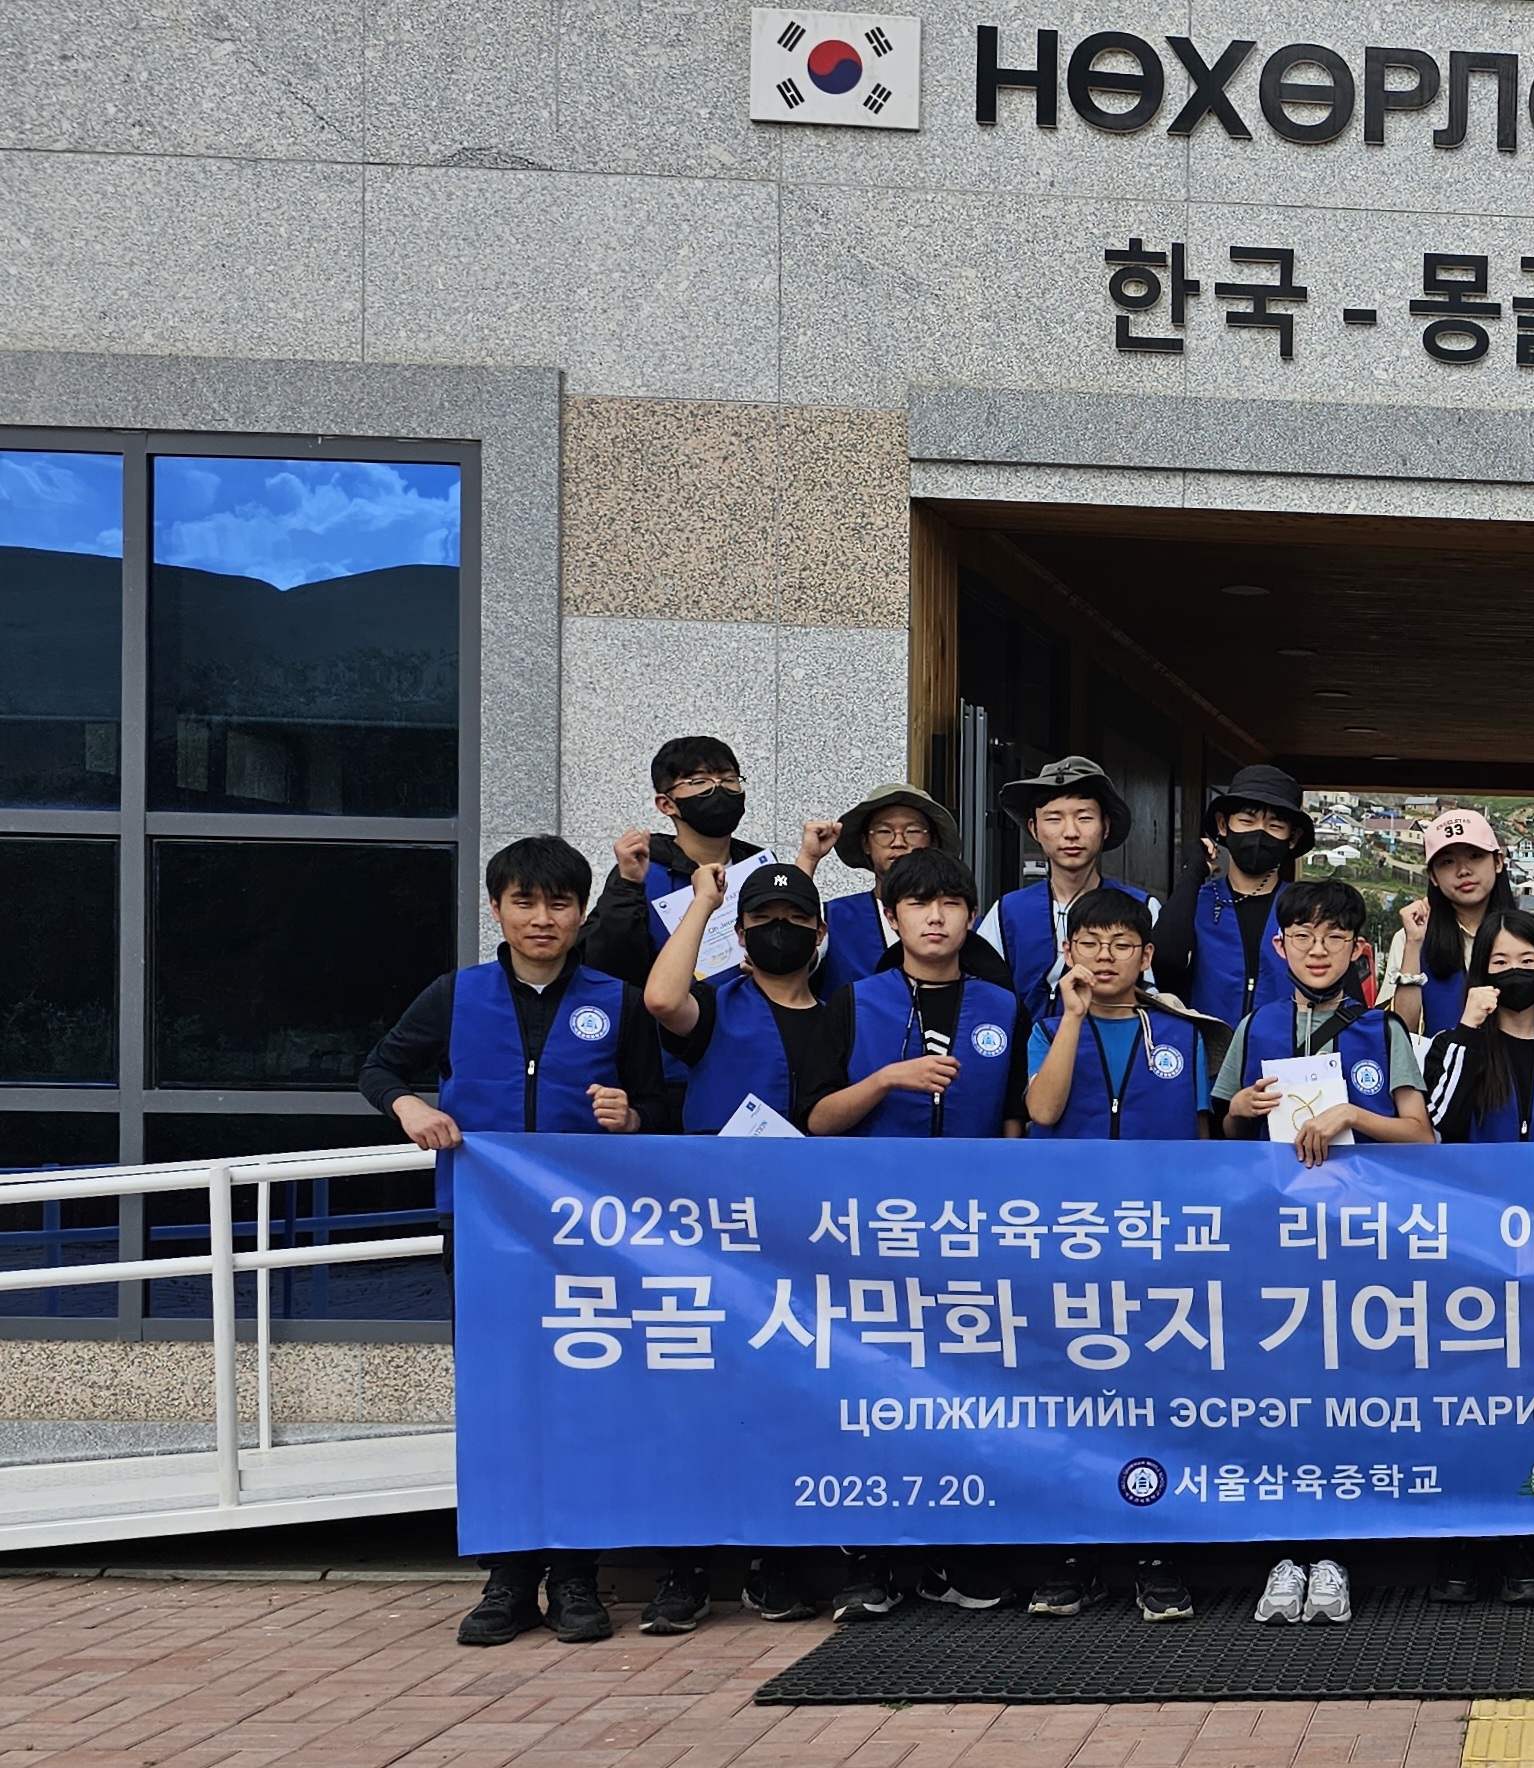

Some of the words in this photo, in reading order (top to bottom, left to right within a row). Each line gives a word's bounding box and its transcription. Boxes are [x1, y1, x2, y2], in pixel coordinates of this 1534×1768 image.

[1104, 237, 1308, 362] 한국
[1444, 823, 1464, 838] 33
[551, 1195, 761, 1252] 2023년
[808, 1198, 1230, 1260] 서울삼육중학교
[1279, 1201, 1448, 1260] 리더십
[541, 1274, 726, 1370] 몽골
[748, 1274, 1028, 1369] 사막화
[1052, 1280, 1225, 1371] 방지
[1258, 1279, 1521, 1370] 기여의
[840, 1389, 1155, 1437] ЦӨЛЖИЛТИЙН
[1169, 1397, 1312, 1428] ЭСРЭГ
[1325, 1396, 1421, 1433] МОД
[794, 1474, 995, 1507] 2023.7.20.
[1174, 1464, 1442, 1503] 서울삼육중학교
